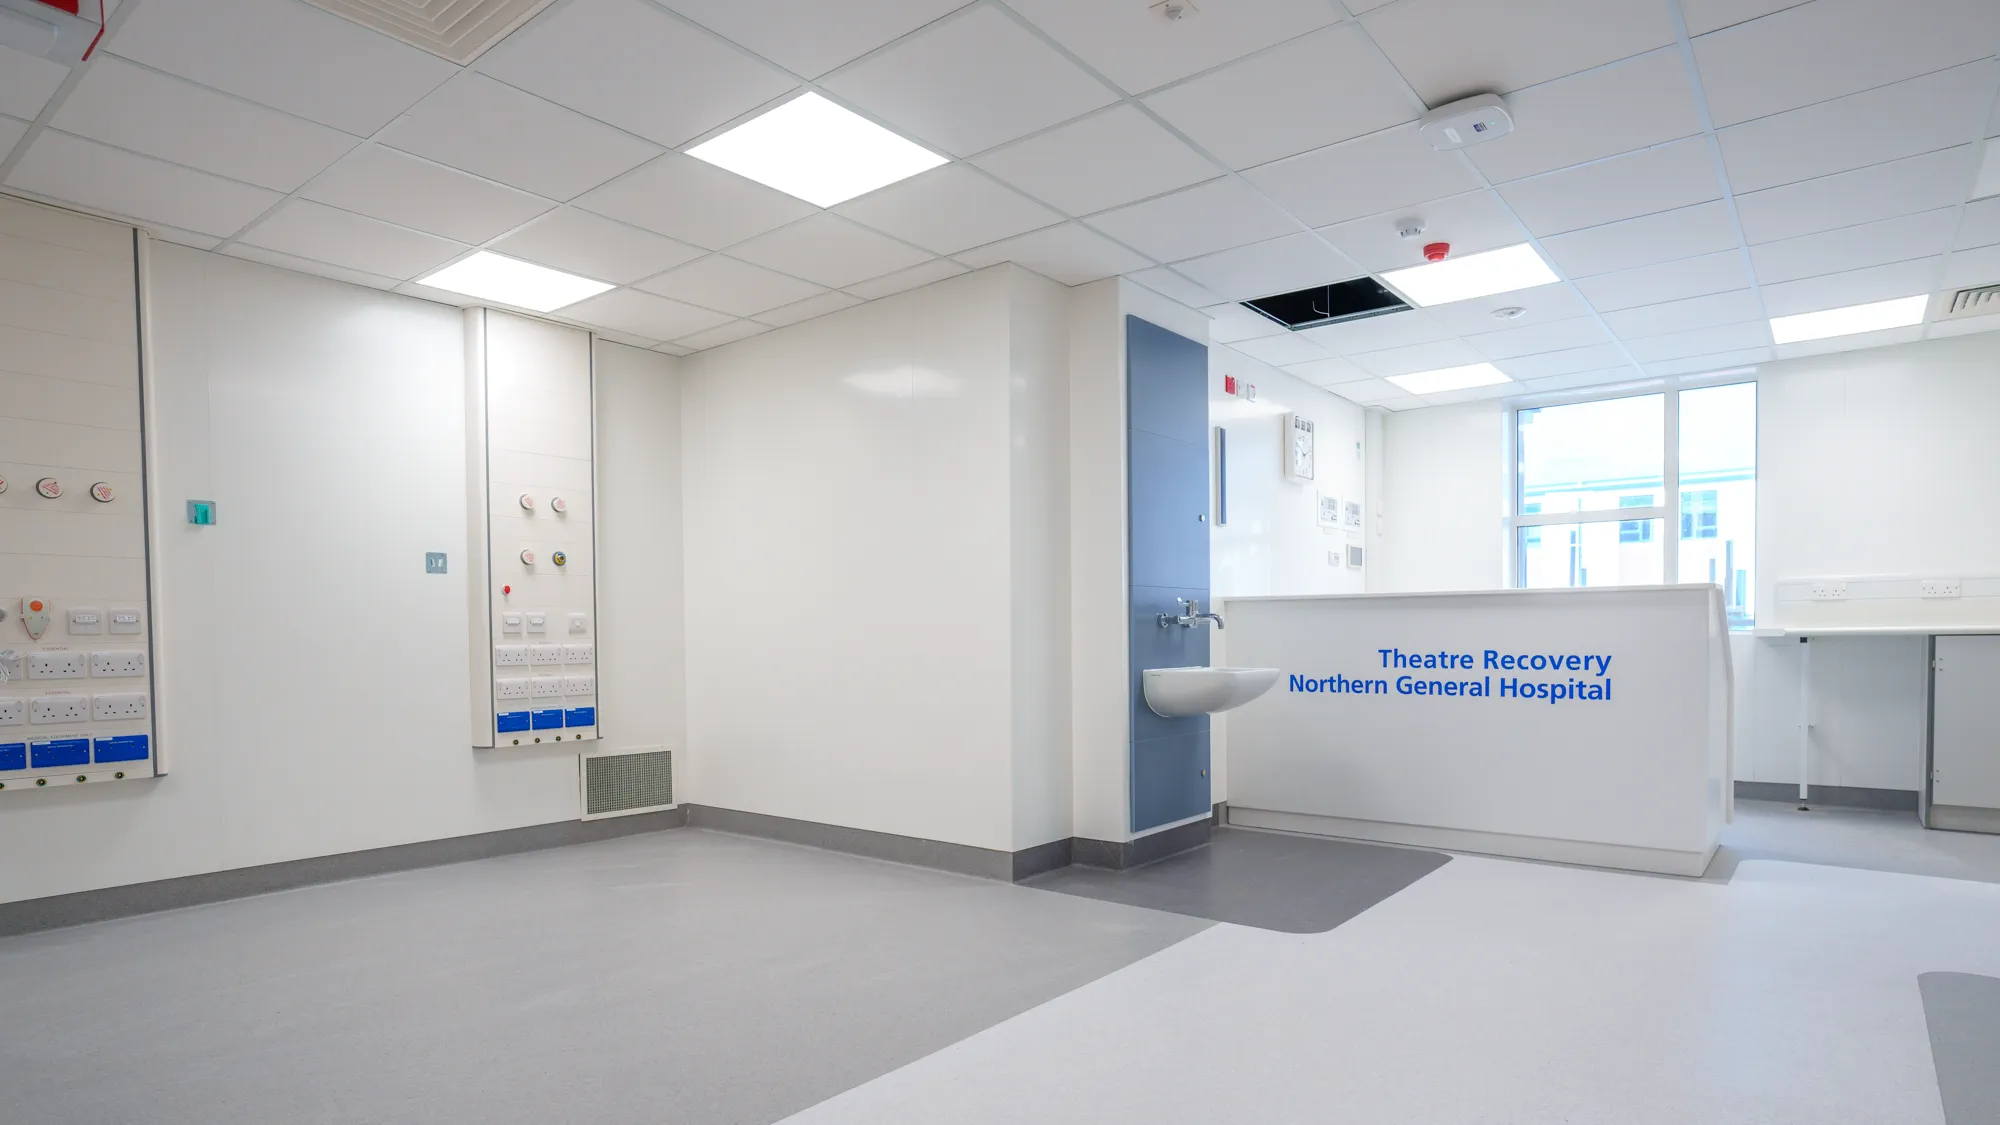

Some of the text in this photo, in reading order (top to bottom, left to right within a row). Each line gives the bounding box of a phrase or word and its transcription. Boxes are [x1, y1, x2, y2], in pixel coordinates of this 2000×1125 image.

[1377, 647, 1613, 677] Theatre Recovery
[1289, 673, 1612, 705] Northern General Hospital
